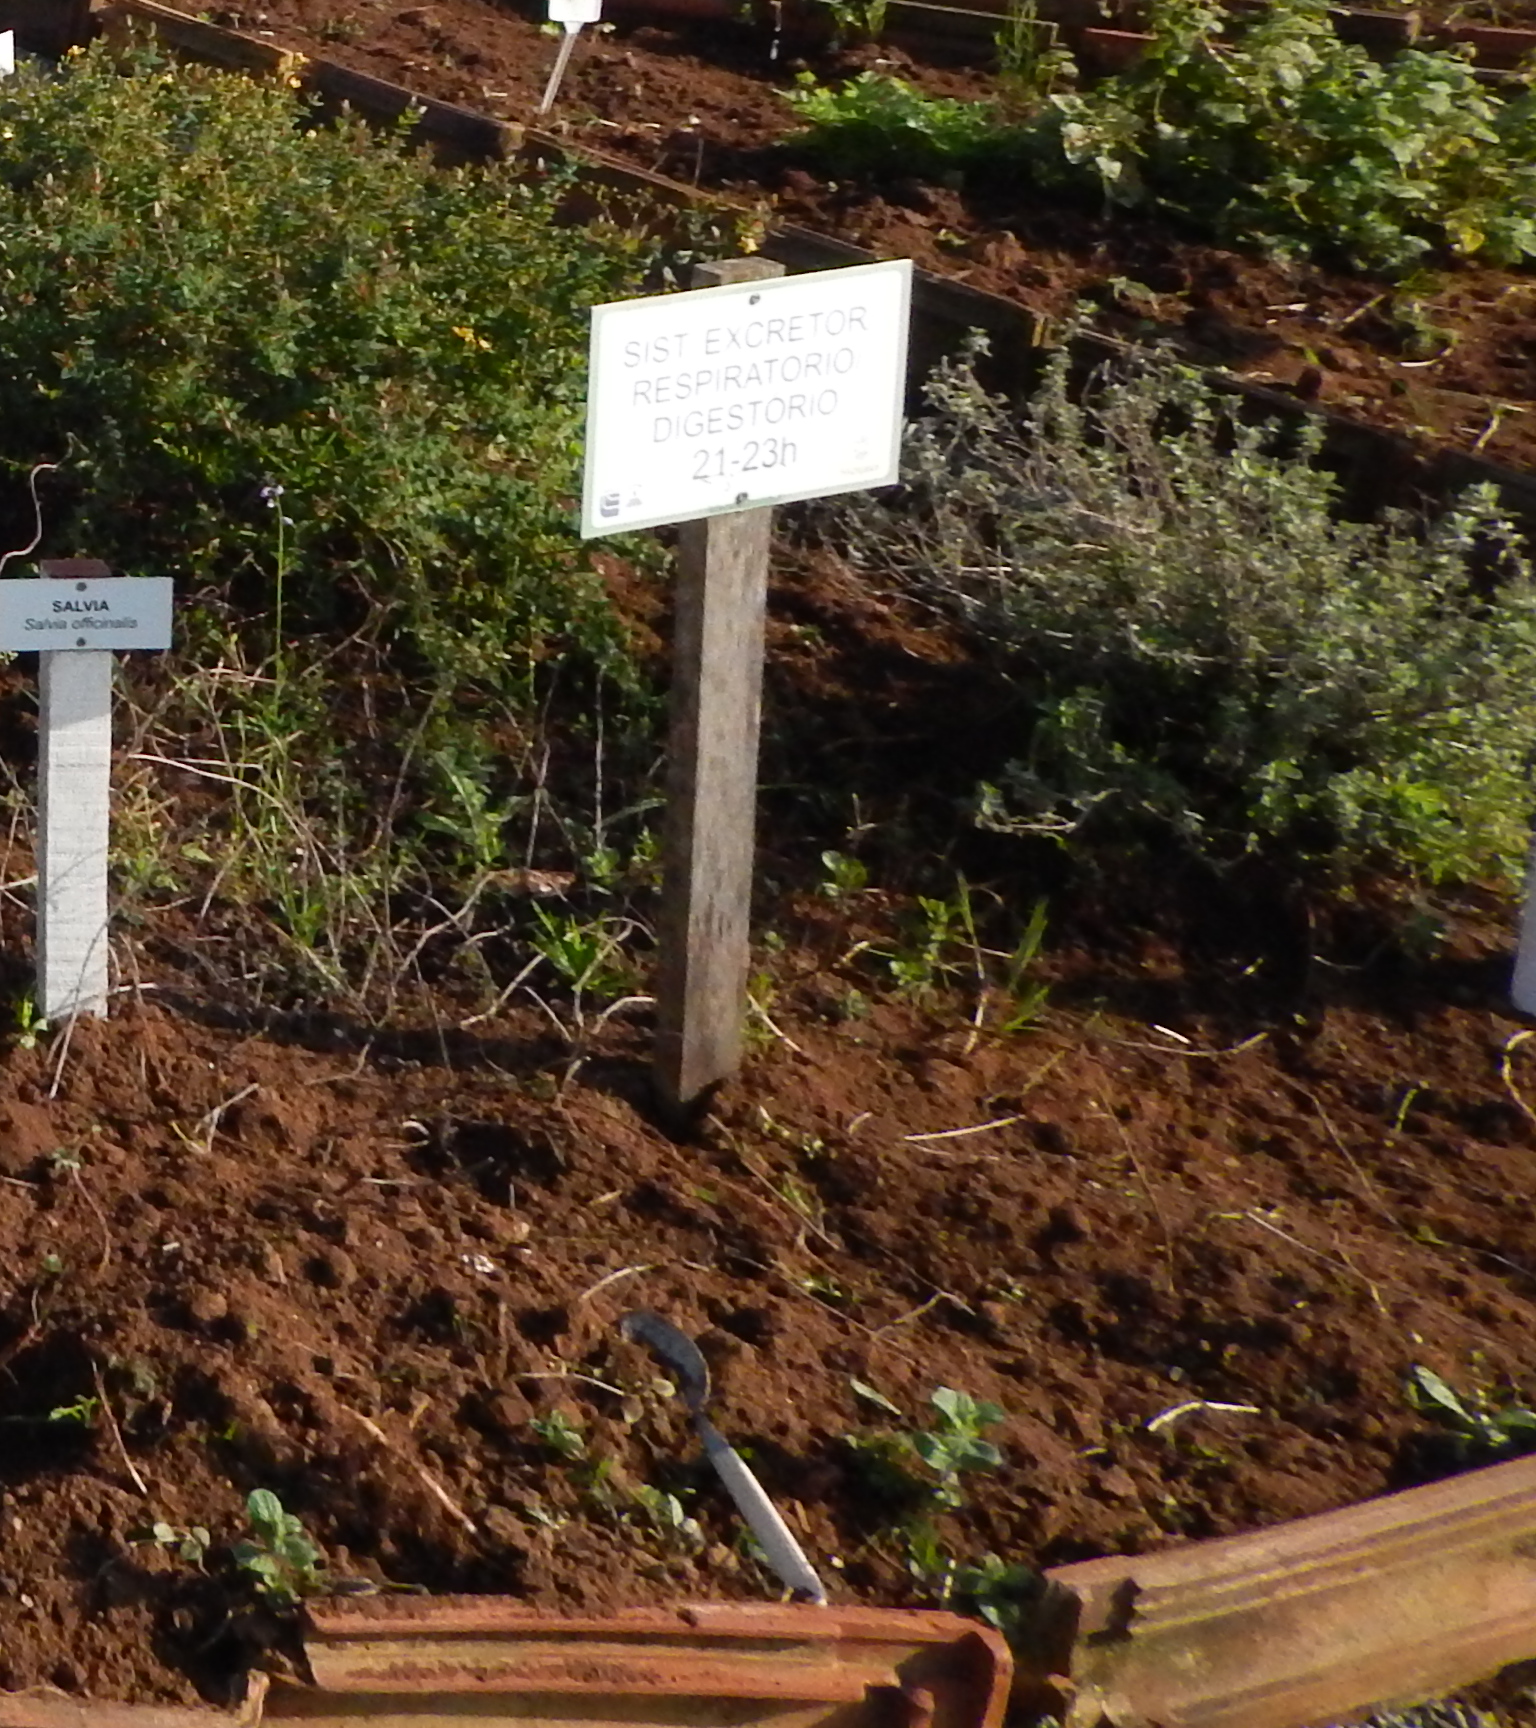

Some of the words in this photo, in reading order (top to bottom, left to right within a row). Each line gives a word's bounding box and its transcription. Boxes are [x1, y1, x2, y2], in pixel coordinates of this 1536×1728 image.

[624, 332, 687, 368] SIST
[705, 306, 869, 355] EXCRETOR
[693, 436, 797, 480] 21-23h
[52, 600, 110, 613] SALVIA
[24, 617, 67, 631] Salvia
[70, 616, 138, 630] officinalis
